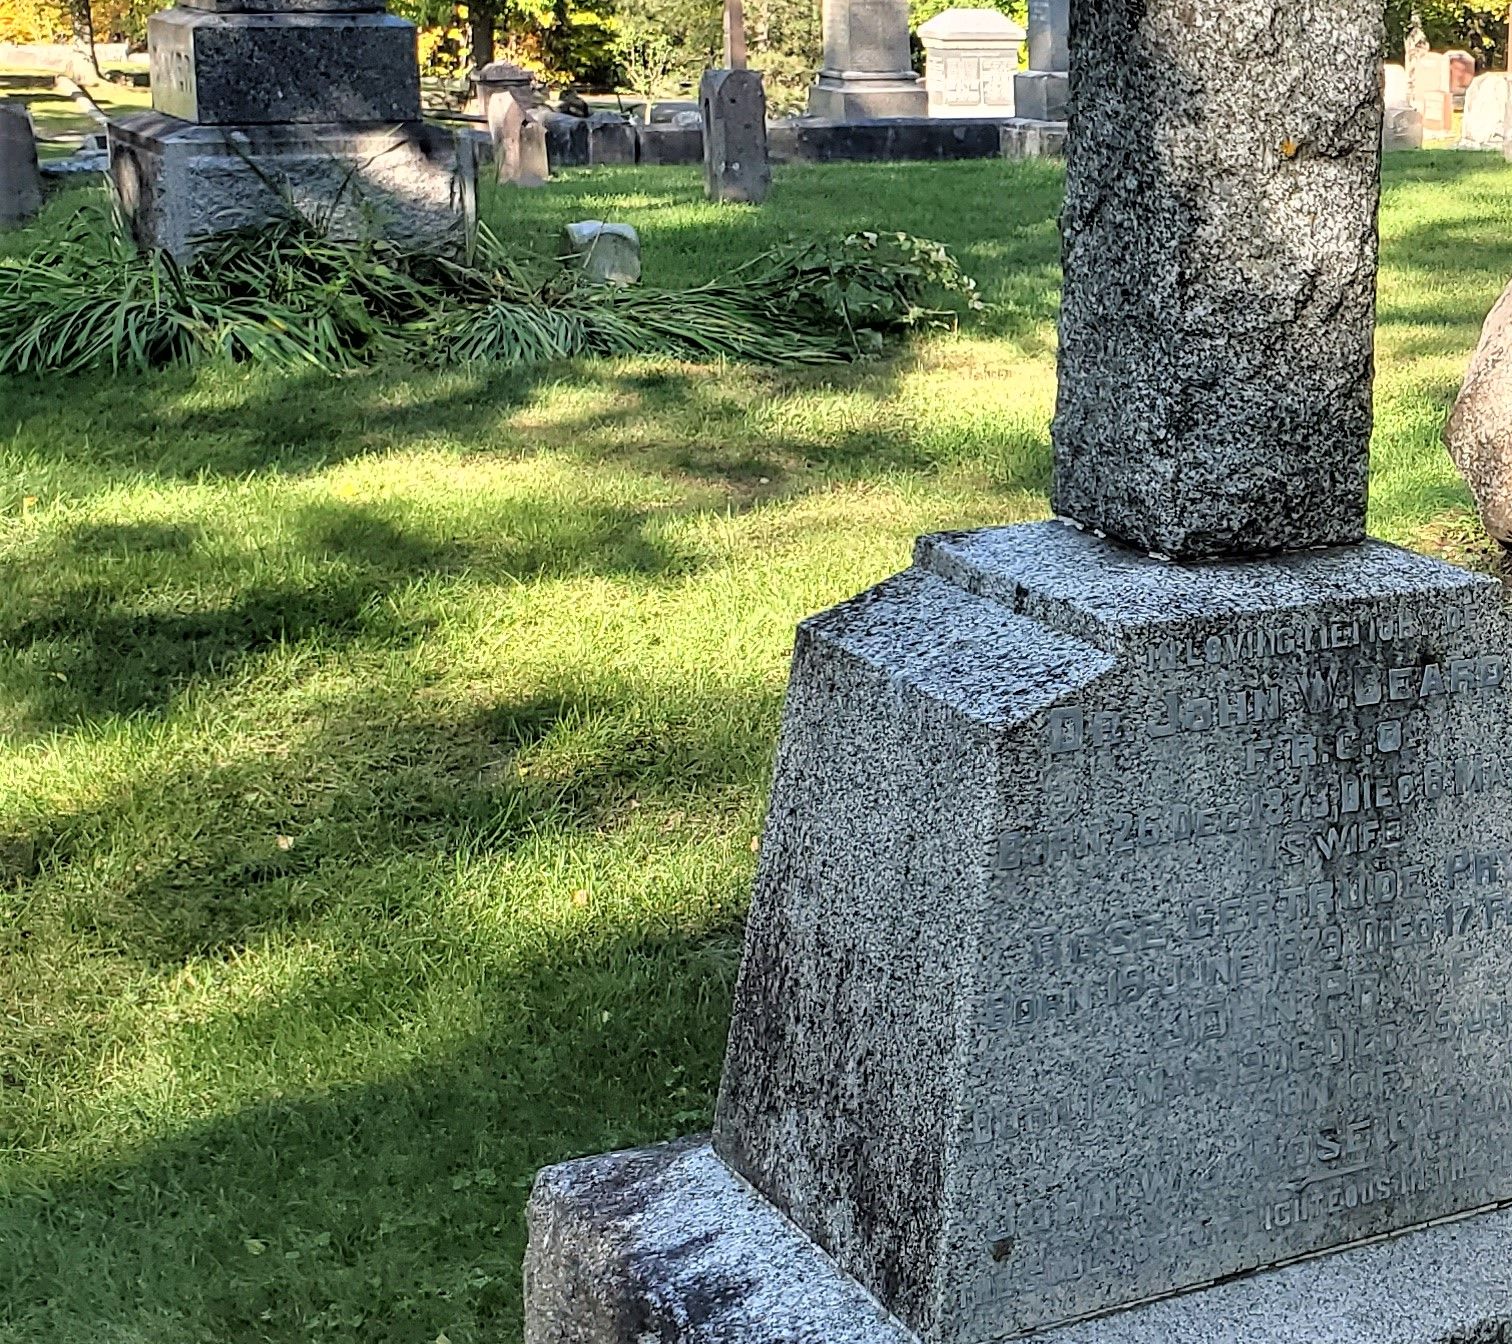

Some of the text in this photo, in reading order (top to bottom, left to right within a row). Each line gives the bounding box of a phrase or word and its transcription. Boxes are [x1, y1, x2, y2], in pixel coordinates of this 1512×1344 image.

[1185, 626, 1295, 667] LOVING
[1144, 678, 1280, 738] JOHN
[1314, 816, 1401, 861] WIFE
[1186, 859, 1425, 942] GERTRUDE
